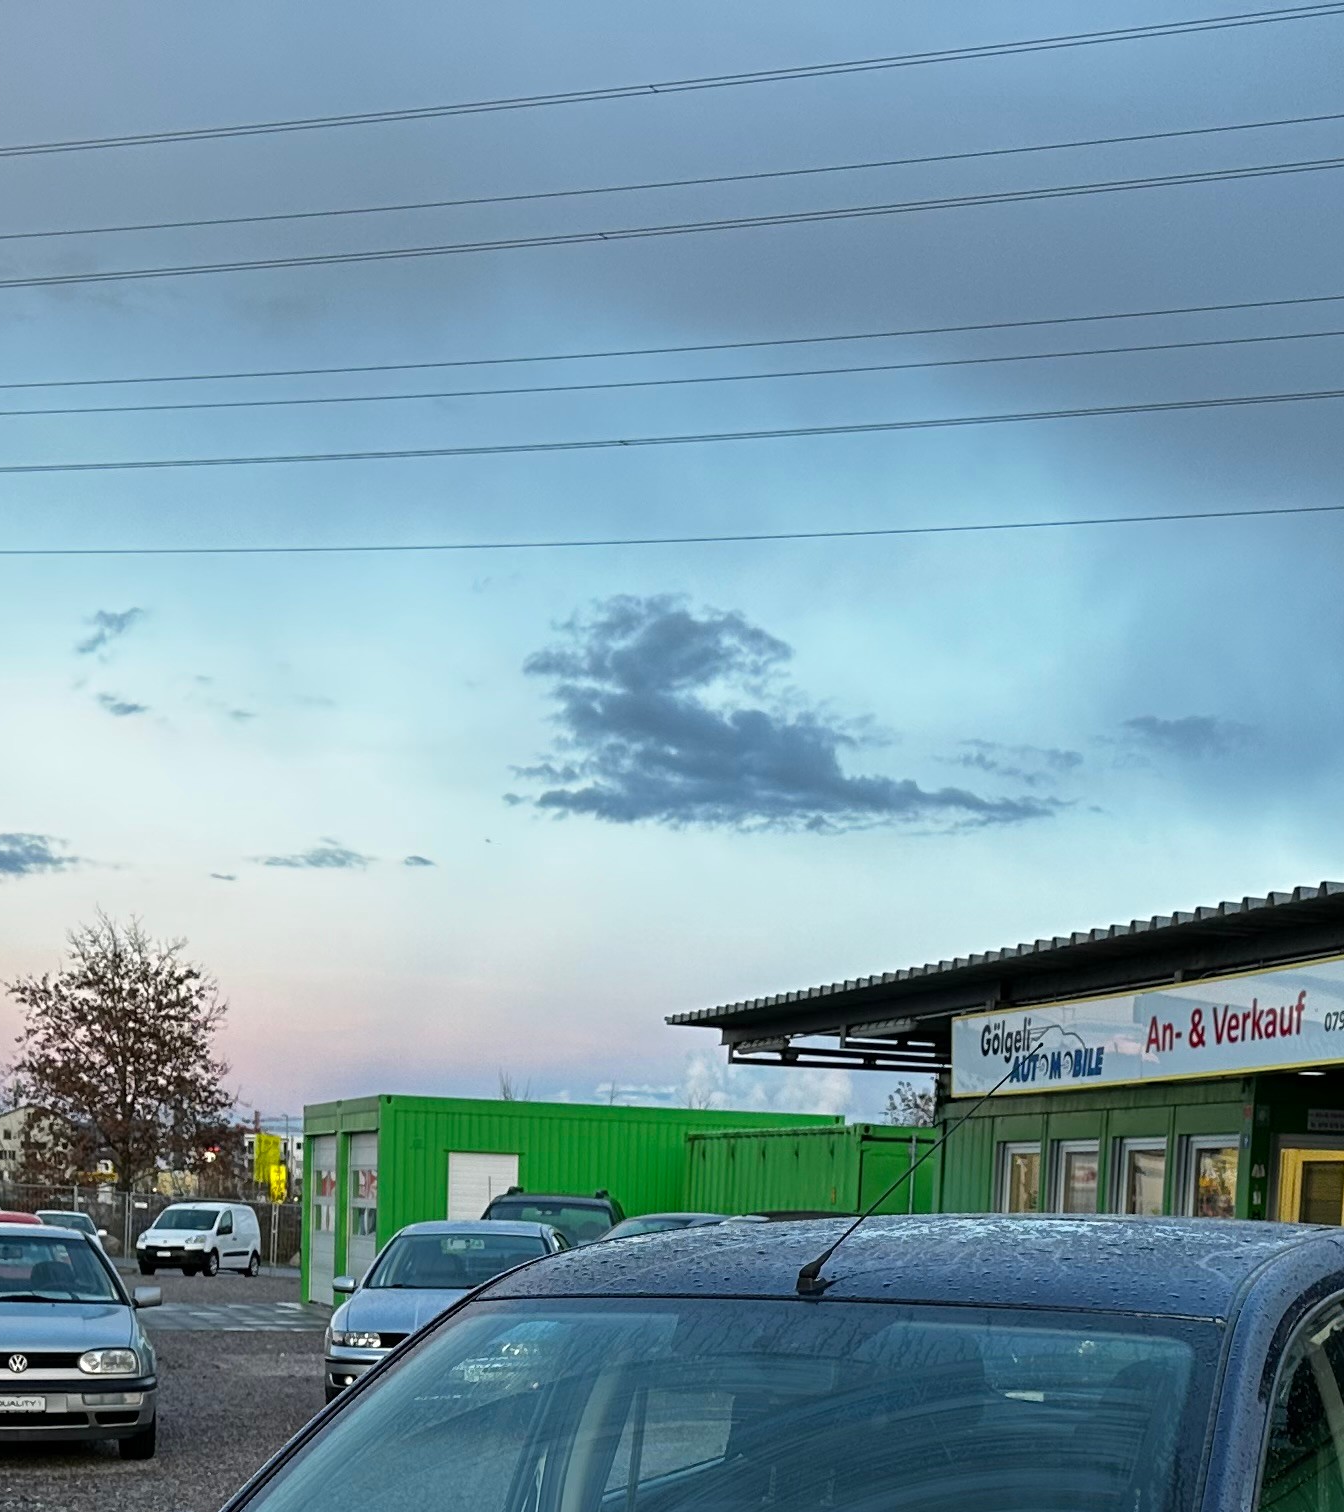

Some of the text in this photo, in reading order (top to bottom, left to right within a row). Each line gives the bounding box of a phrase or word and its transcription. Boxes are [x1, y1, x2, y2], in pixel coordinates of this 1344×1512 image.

[981, 1017, 1032, 1064] Gölgeli
[1146, 990, 1307, 1053] An- & Verkauf
